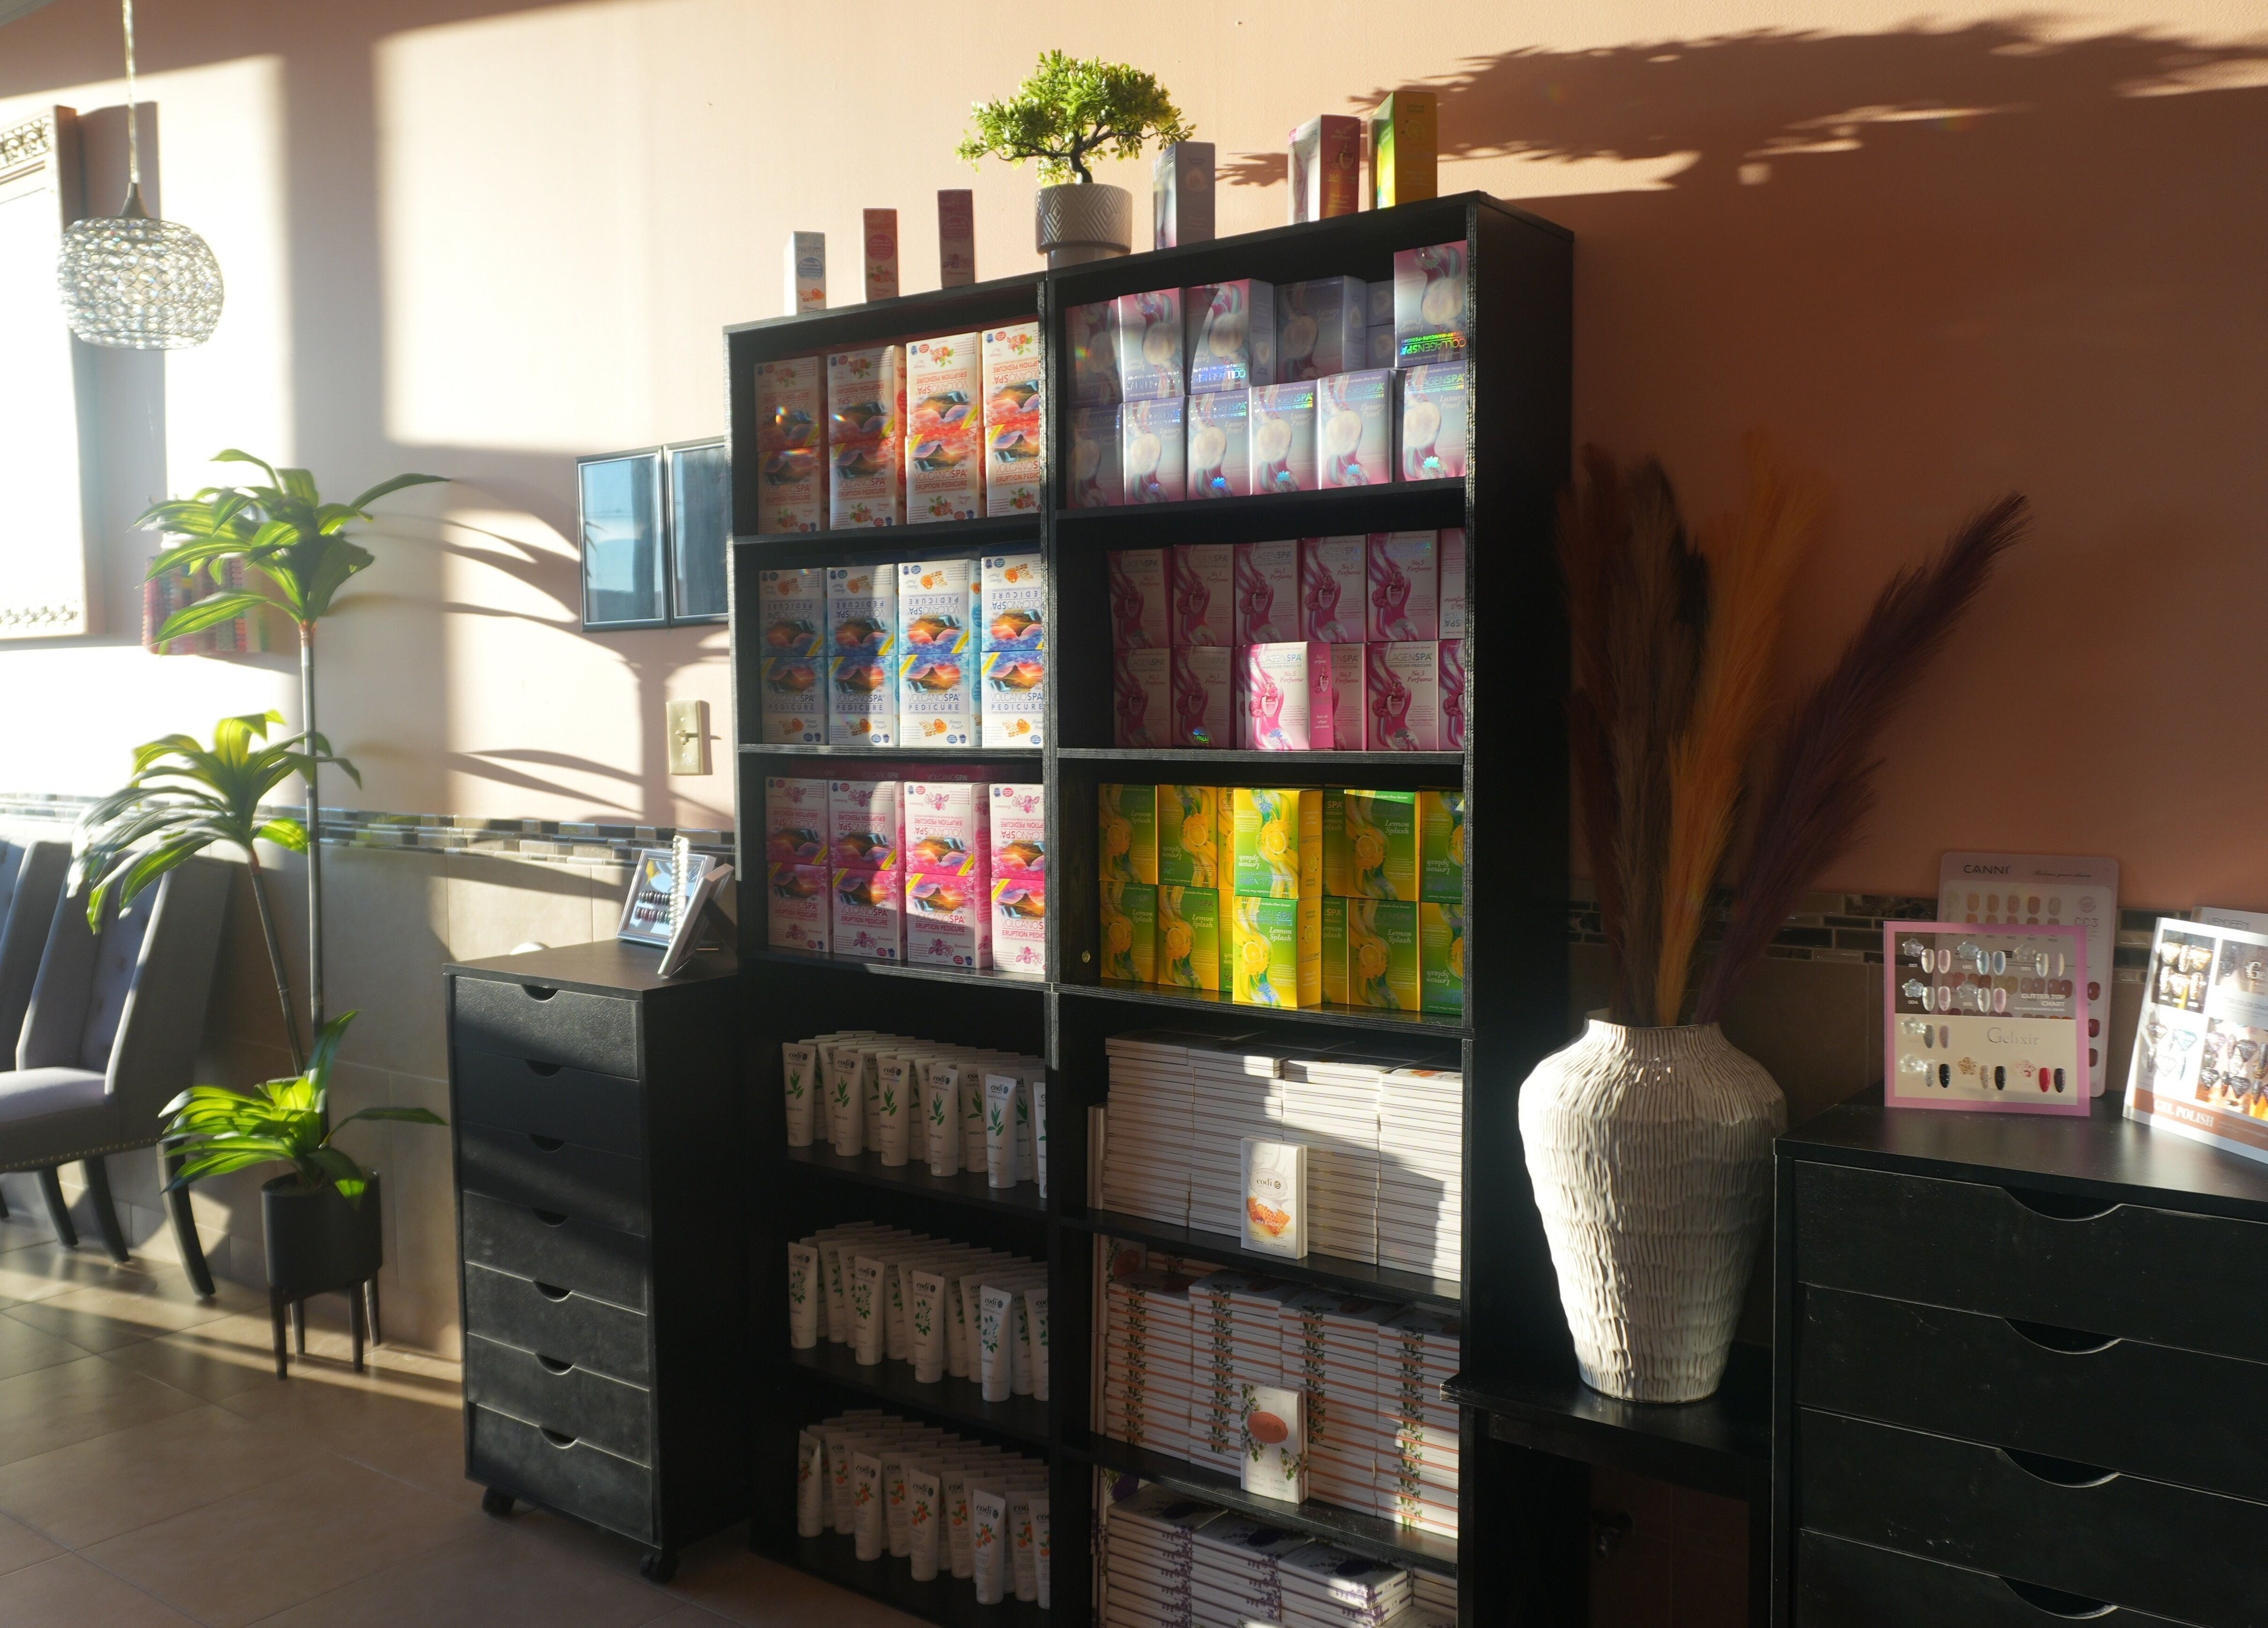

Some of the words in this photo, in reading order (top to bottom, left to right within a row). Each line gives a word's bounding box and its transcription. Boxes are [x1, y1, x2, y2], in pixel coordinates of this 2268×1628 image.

[1400, 338, 1466, 356] COLLAGENSPA
[992, 366, 1018, 377] PEDICURE
[1019, 362, 1038, 373] UPTION
[916, 375, 941, 385] PEDICURE
[942, 372, 967, 382] ERUPTION
[993, 370, 1038, 386] OLCANOSPA
[917, 379, 969, 395] VOLCANOSPA
[1439, 394, 1465, 403] Luxury
[1360, 401, 1386, 411] Luxury
[1441, 401, 1461, 410] Pearl
[1363, 409, 1381, 418] Pearl
[996, 460, 1039, 473] VOLCANOS
[915, 469, 969, 483] VOLCANOSPA
[996, 474, 1022, 483] ERUPTION
[1024, 471, 1040, 480] PEDIC
[839, 478, 887, 491] VOLCANOSPA
[915, 481, 940, 490] ERUPTION
[941, 479, 967, 488] PEDICURE
[863, 488, 887, 496] PEDICURE
[1337, 569, 1361, 577] Perfume
[1407, 565, 1432, 574] Perfume
[1270, 574, 1293, 582] Perfume
[992, 590, 1038, 600] EDICURE
[836, 600, 884, 608] PEDICURE
[908, 596, 959, 605] PEDICURE
[992, 599, 1041, 611] OLCANOSPA
[836, 608, 885, 618] VOLCANOSPA
[908, 604, 960, 615] VOLCANOSPA
[1407, 676, 1433, 685] Perfume
[836, 693, 884, 703] VOLCANOSPA
[908, 692, 960, 702] VOLCANOSPA
[991, 692, 1043, 702] VOLCANOSPA
[836, 703, 883, 711] PEDICURE
[1131, 816, 1152, 824] Splash
[1384, 819, 1410, 828] Lemon
[838, 822, 887, 832] VOLCANOSPA
[915, 826, 963, 837] VOLCANOSPA
[1385, 826, 1410, 835] Splash
[1001, 829, 1044, 840] LCANOSPA
[1239, 855, 1259, 864] Splash
[1426, 859, 1451, 867] Splash
[1238, 862, 1260, 870] Lemon
[1426, 865, 1451, 875] Lemon
[1963, 864, 2009, 875] CANNI
[841, 905, 888, 917] VOLCANOSPA
[865, 918, 888, 926] PEDICURE
[915, 913, 965, 925] VOLCANOSPA
[1133, 914, 1153, 923] Splash
[1192, 913, 1214, 922] Lemon
[915, 922, 940, 930] ERUPTION
[941, 924, 965, 933] PEDICURE
[1001, 918, 1044, 930] VOLCANOS
[1192, 920, 1214, 929] Splash
[1324, 925, 1342, 933] emon
[1002, 929, 1026, 937] ERUPTION
[1027, 932, 1045, 940] PEDIC
[1269, 926, 1293, 935] Lemon
[1387, 928, 1412, 937] Lemon
[1270, 933, 1292, 942] Splash
[1388, 935, 1412, 945] Splash
[1426, 969, 1451, 978] Splash
[1426, 976, 1451, 986] Lemon
[1986, 1026, 2040, 1045] Gelixir
[884, 1067, 897, 1076] codi
[933, 1075, 946, 1083] codi
[990, 1083, 1003, 1093] codi
[2153, 1099, 2172, 1116] GEL
[2175, 1105, 2215, 1128] POLISH
[1256, 1177, 1275, 1187] codi
[985, 1297, 998, 1306] codi
[976, 1504, 992, 1515] codi
